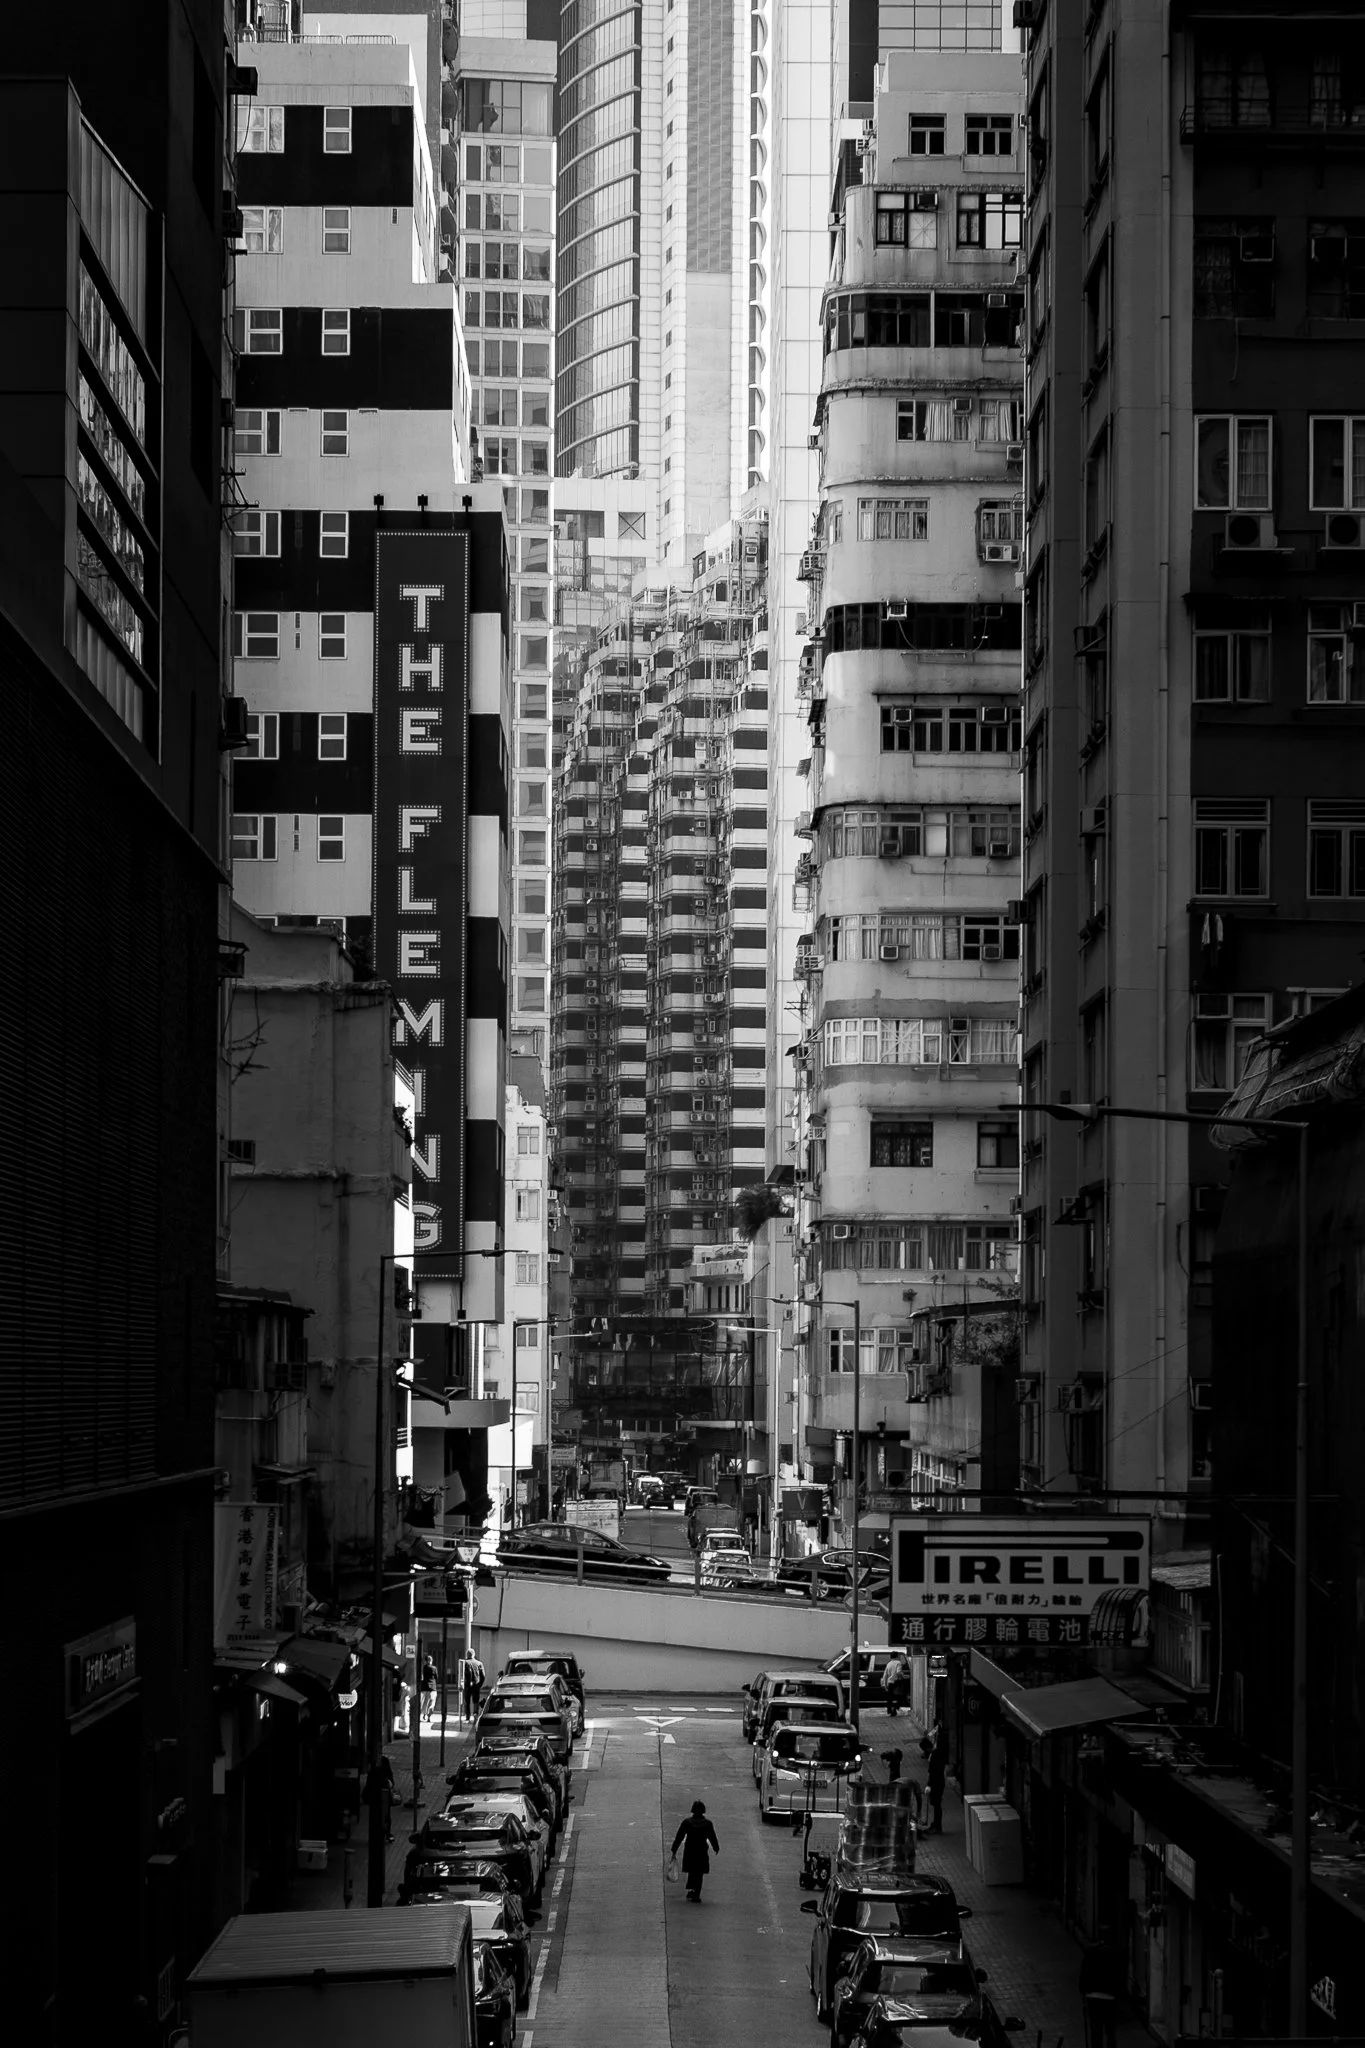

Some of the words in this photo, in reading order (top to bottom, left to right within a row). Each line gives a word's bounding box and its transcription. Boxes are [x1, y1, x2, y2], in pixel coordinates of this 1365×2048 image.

[398, 584, 444, 755] THE
[393, 804, 445, 1251] FLEMING
[898, 1530, 1144, 1584] PIRELLI
[902, 1616, 1081, 1642] 通行膠輪電池
